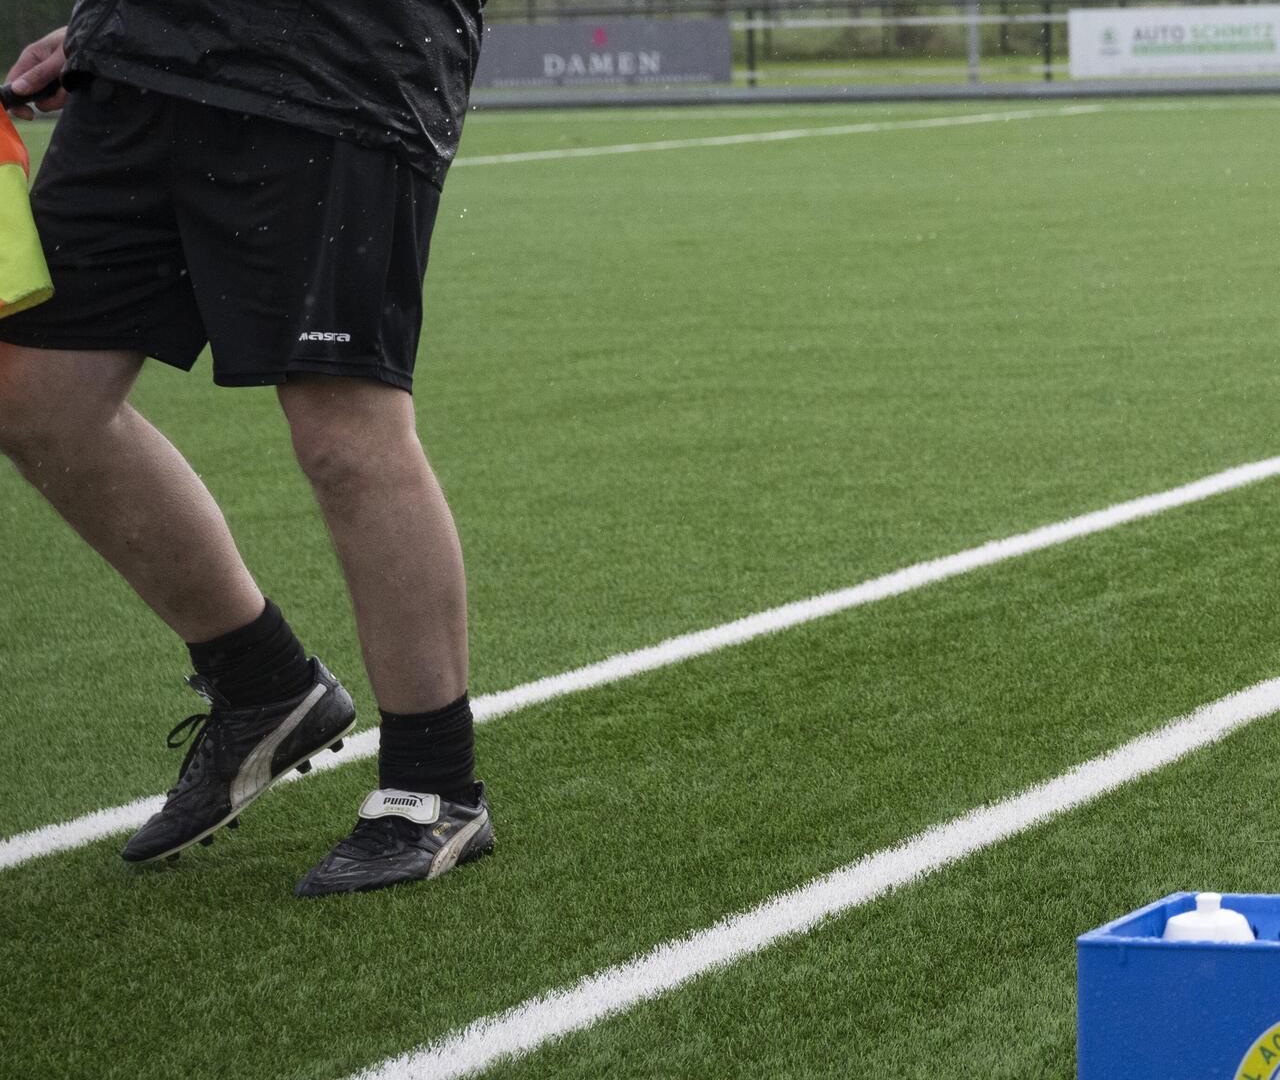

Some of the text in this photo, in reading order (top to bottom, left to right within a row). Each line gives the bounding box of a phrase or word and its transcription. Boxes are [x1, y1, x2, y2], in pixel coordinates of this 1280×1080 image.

[1133, 23, 1186, 42] AUTO
[543, 50, 661, 77] DAMEN
[383, 797, 417, 808] PUMA
